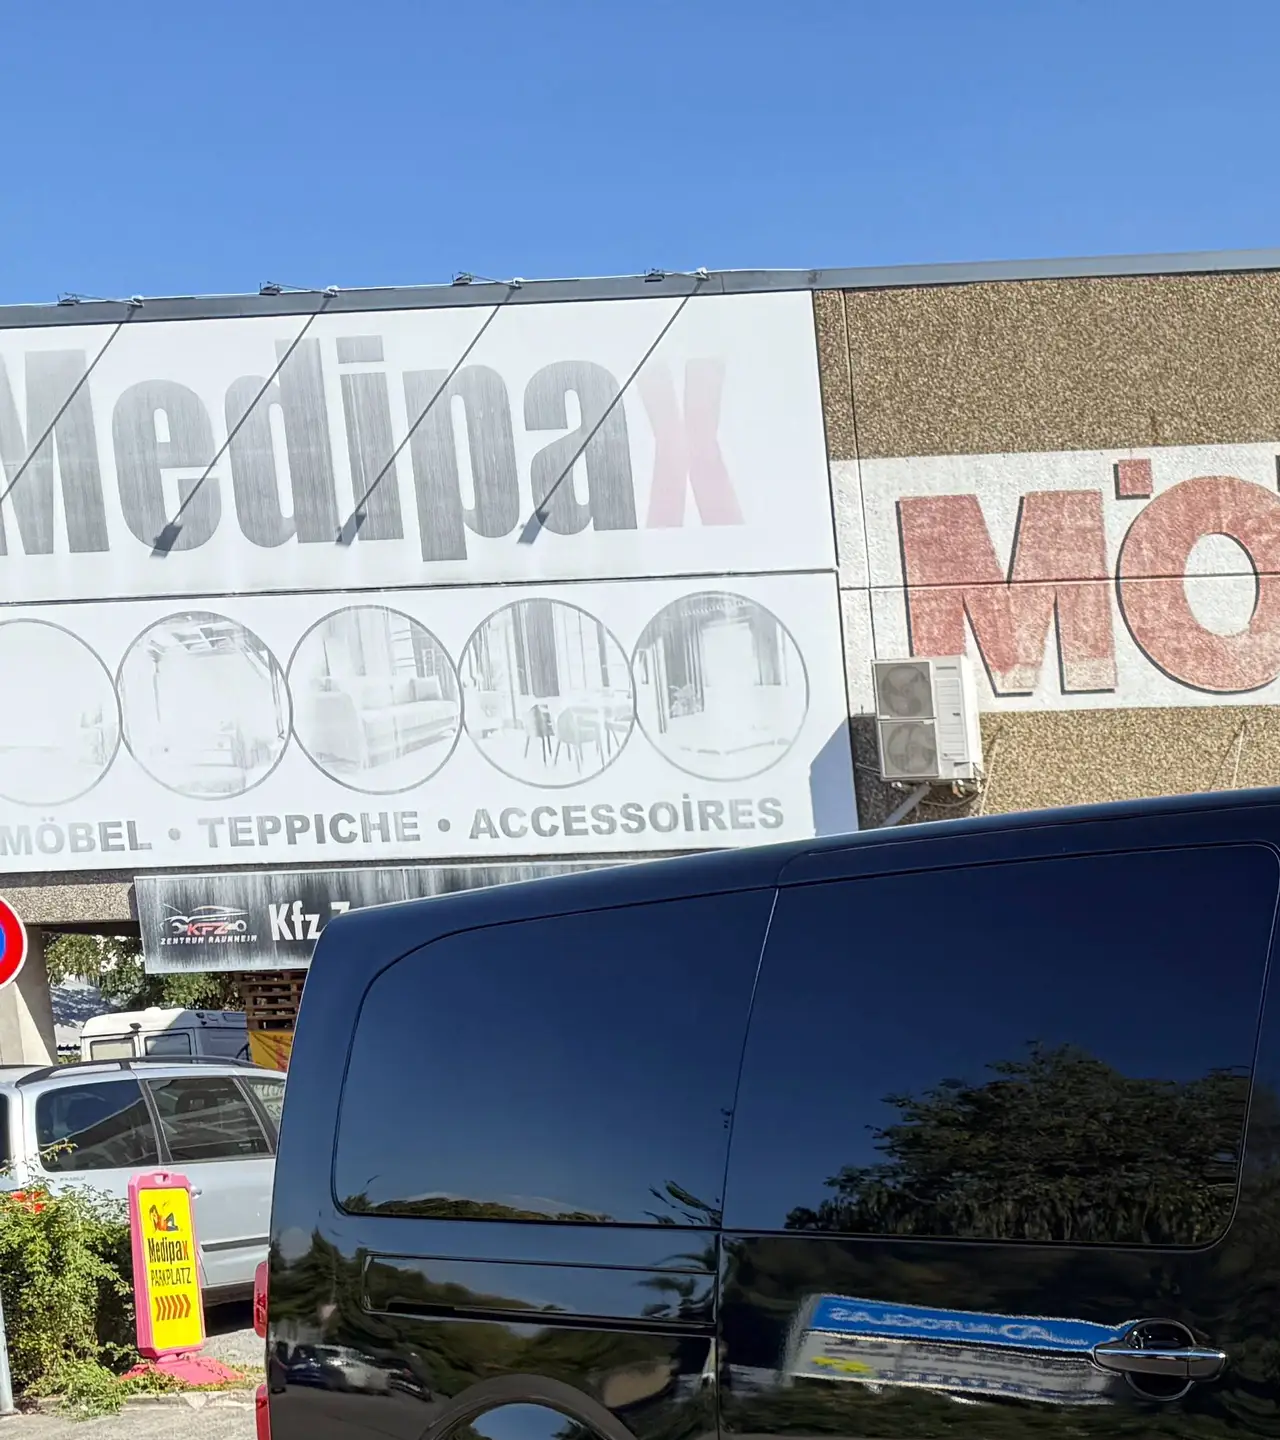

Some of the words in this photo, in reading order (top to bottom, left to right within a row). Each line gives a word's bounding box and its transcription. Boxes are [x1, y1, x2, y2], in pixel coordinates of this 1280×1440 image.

[0, 335, 745, 562] Medipax
[0, 815, 153, 857] MÖBEL
[197, 810, 422, 849] TEPPICHE
[186, 922, 231, 936] KFZ
[268, 899, 322, 942] Kfz
[160, 935, 205, 946] ZENTRUM
[147, 1236, 190, 1266] Medipax
[150, 1266, 193, 1288] PARKPLATZ
